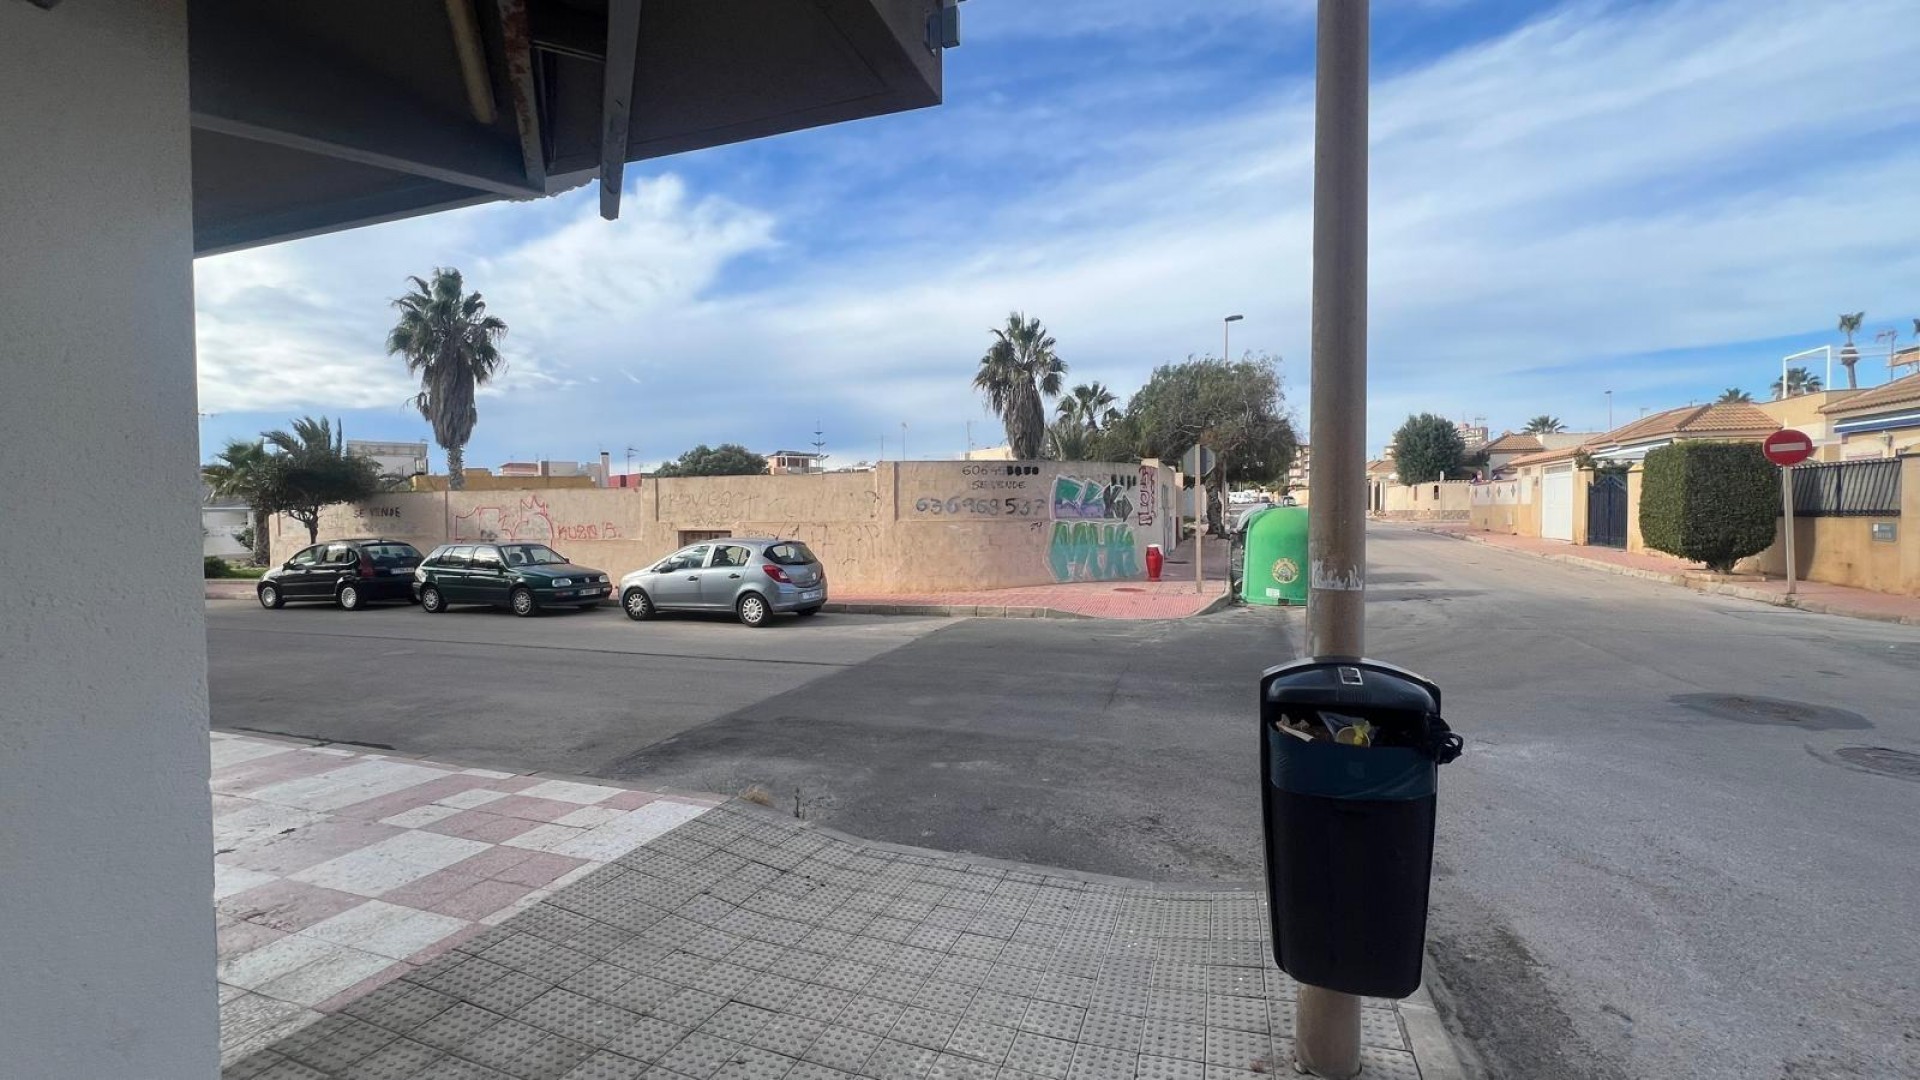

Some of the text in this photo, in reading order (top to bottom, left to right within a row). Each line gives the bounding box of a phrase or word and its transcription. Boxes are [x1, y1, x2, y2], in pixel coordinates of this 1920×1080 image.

[972, 480, 986, 490] SE
[352, 507, 401, 518] SE VENDE
